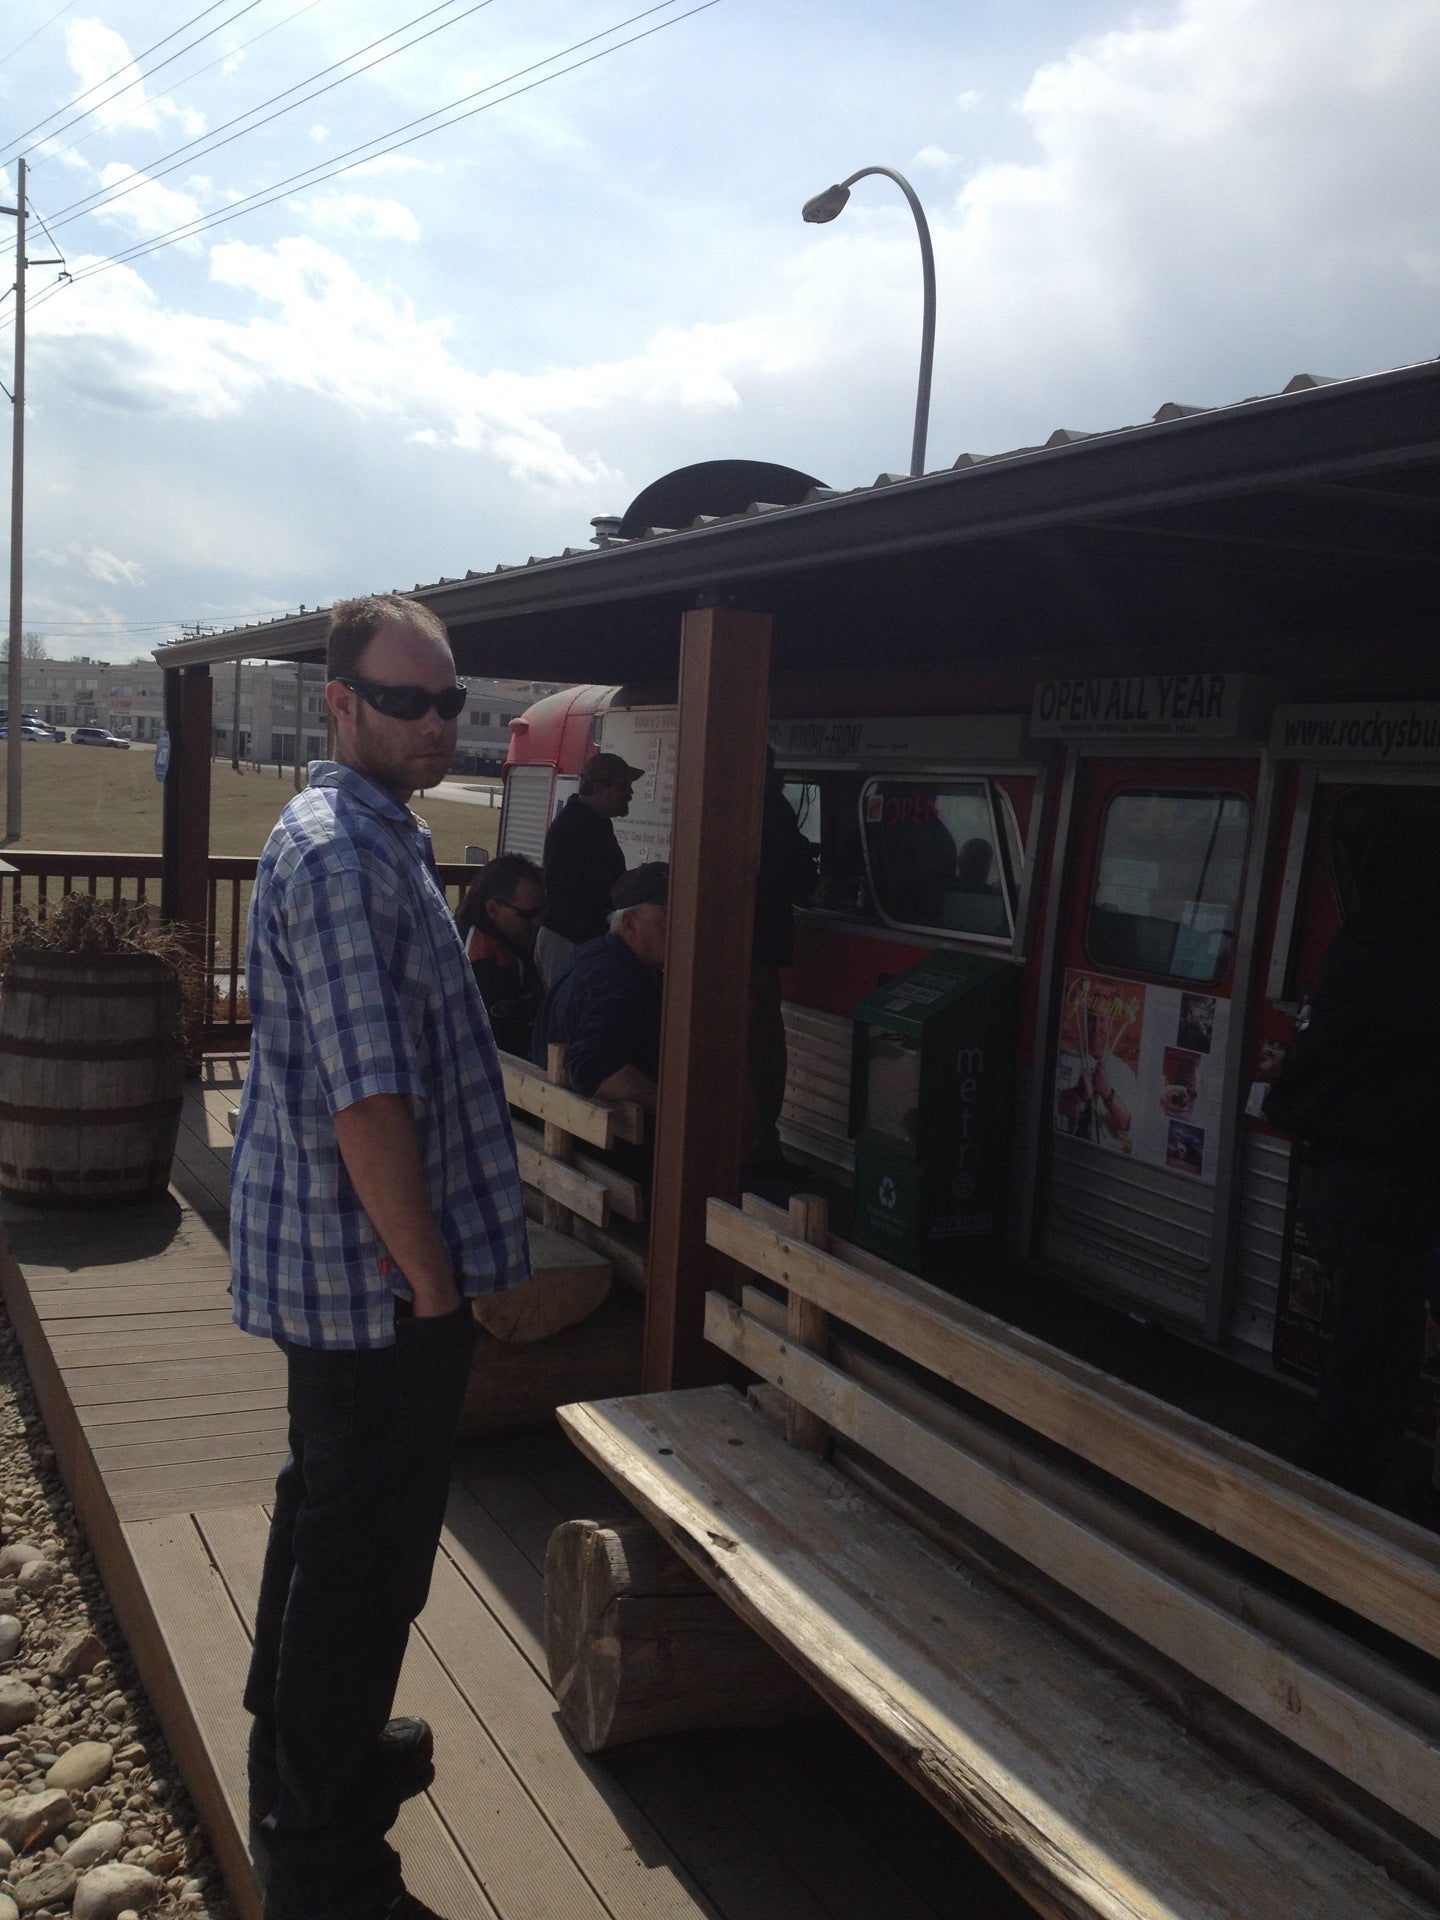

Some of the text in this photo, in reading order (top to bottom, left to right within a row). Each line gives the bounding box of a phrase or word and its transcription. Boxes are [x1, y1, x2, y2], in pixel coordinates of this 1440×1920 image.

[1039, 674, 1227, 721] OPEN ALL YEAR
[1284, 708, 1440, 758] www.rockysbu
[886, 793, 940, 825] OPEN
